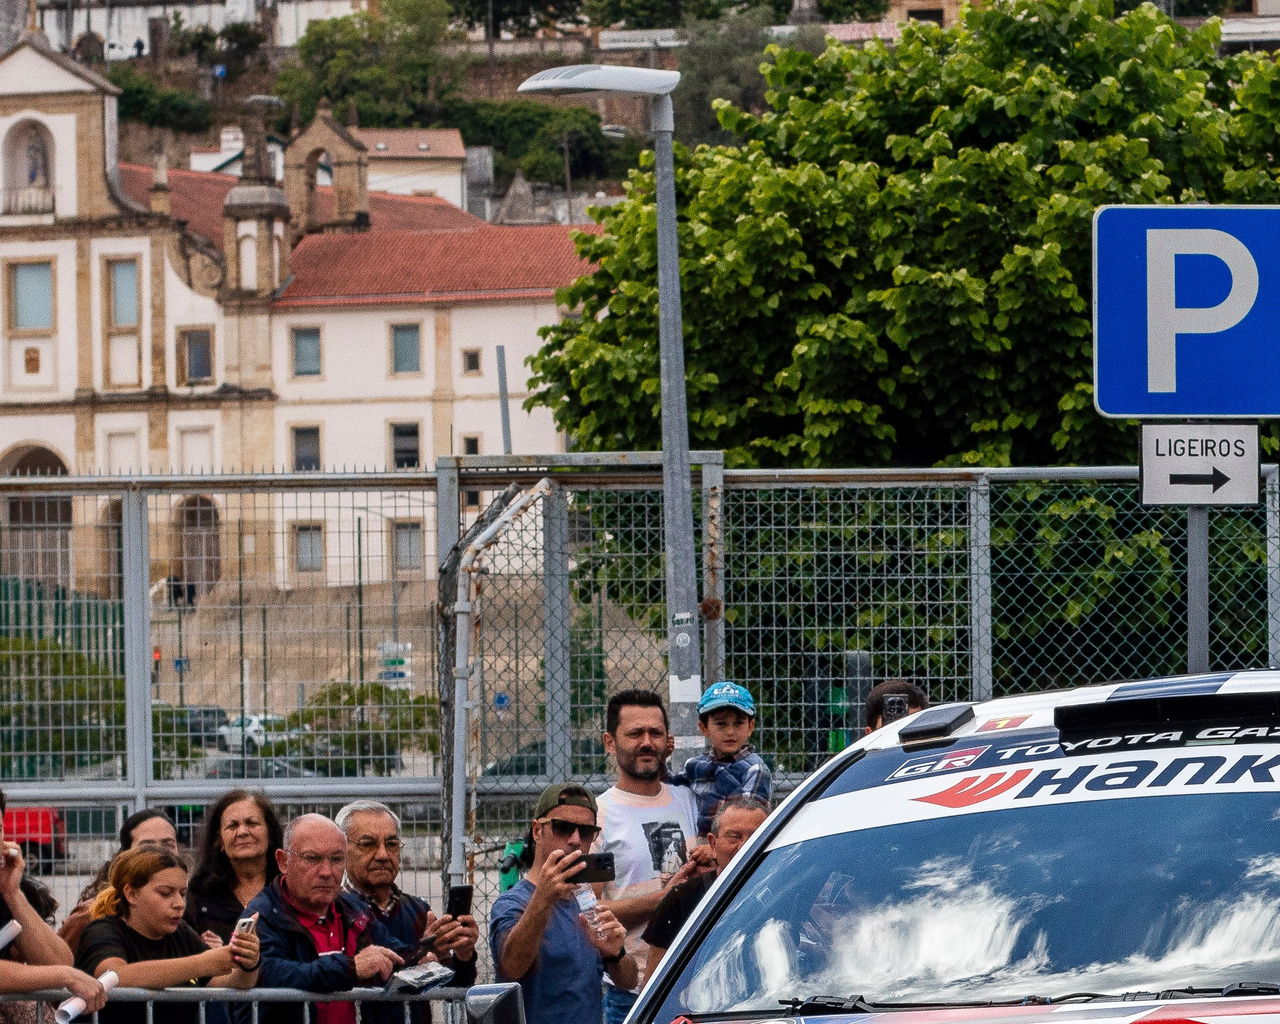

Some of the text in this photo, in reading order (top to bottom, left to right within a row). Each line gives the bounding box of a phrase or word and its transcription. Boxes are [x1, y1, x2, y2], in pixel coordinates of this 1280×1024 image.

[1146, 228, 1259, 393] P
[1155, 438, 1246, 458] LIGEIROS
[997, 730, 1183, 761] TOYOTA
[893, 756, 969, 778] GR
